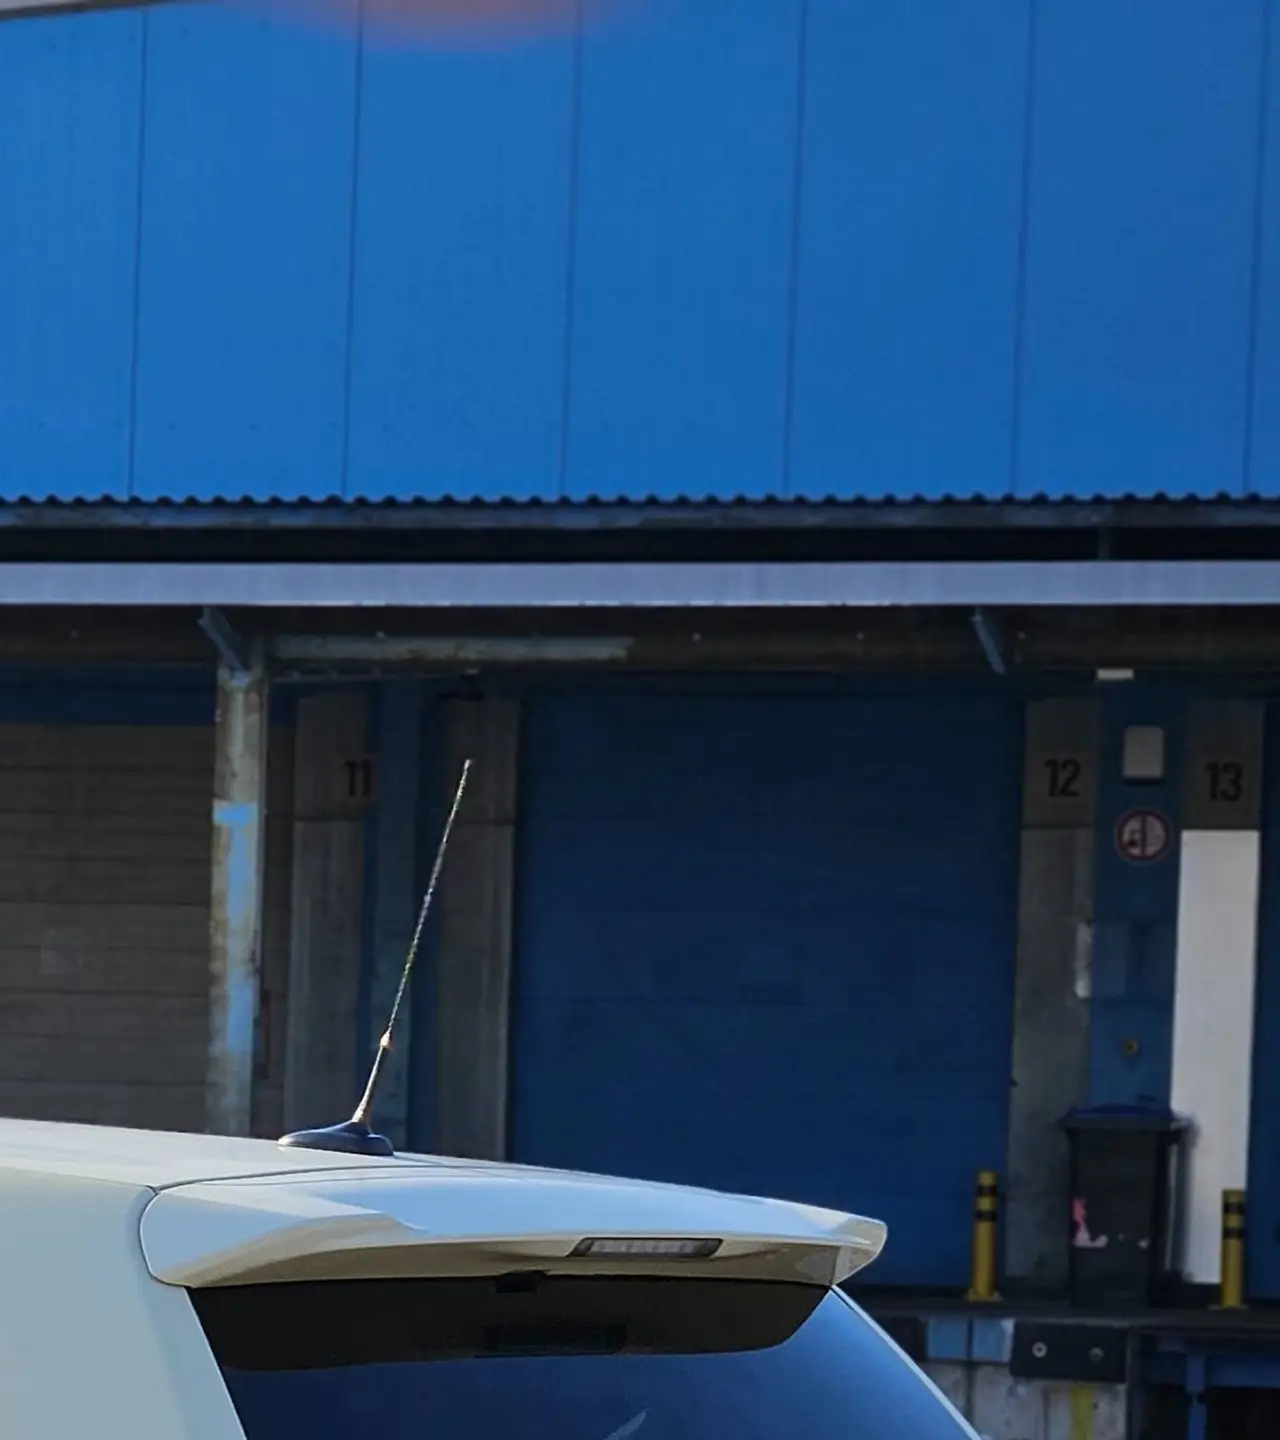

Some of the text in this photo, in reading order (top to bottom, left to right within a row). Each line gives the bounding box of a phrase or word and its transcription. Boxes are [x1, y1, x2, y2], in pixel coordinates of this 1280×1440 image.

[344, 759, 372, 798] 11
[1044, 757, 1081, 797] 12
[1204, 761, 1244, 802] 13
